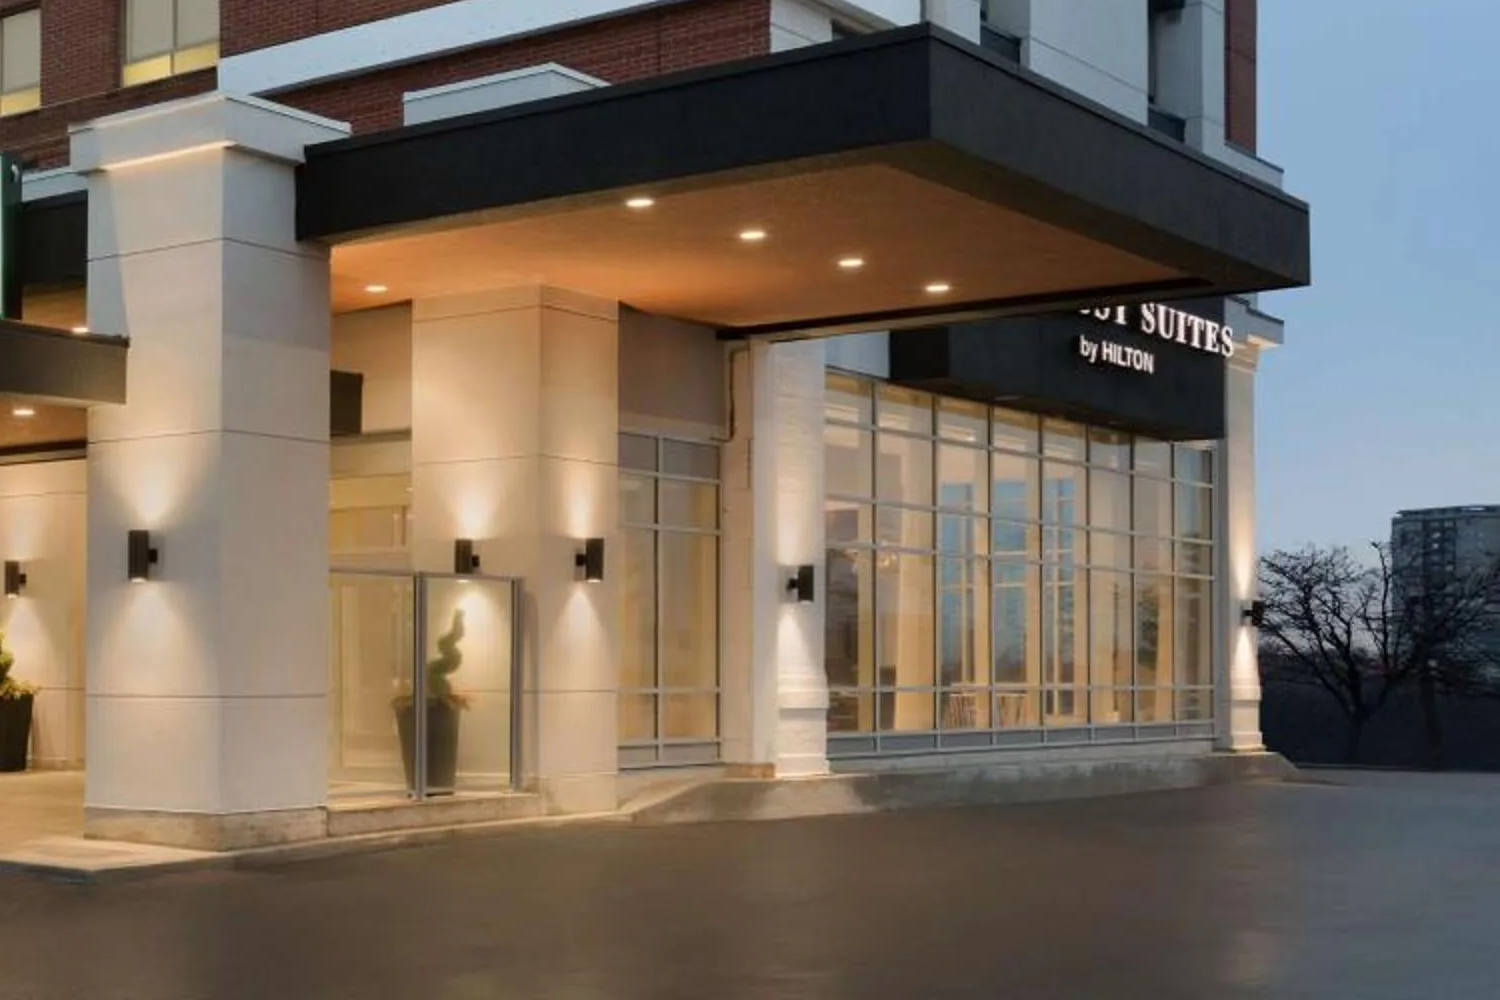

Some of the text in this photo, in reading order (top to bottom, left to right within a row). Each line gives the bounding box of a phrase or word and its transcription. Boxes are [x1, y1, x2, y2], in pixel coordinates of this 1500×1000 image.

[1079, 333, 1154, 373] by HILTON
[1141, 303, 1234, 357] SUITES
